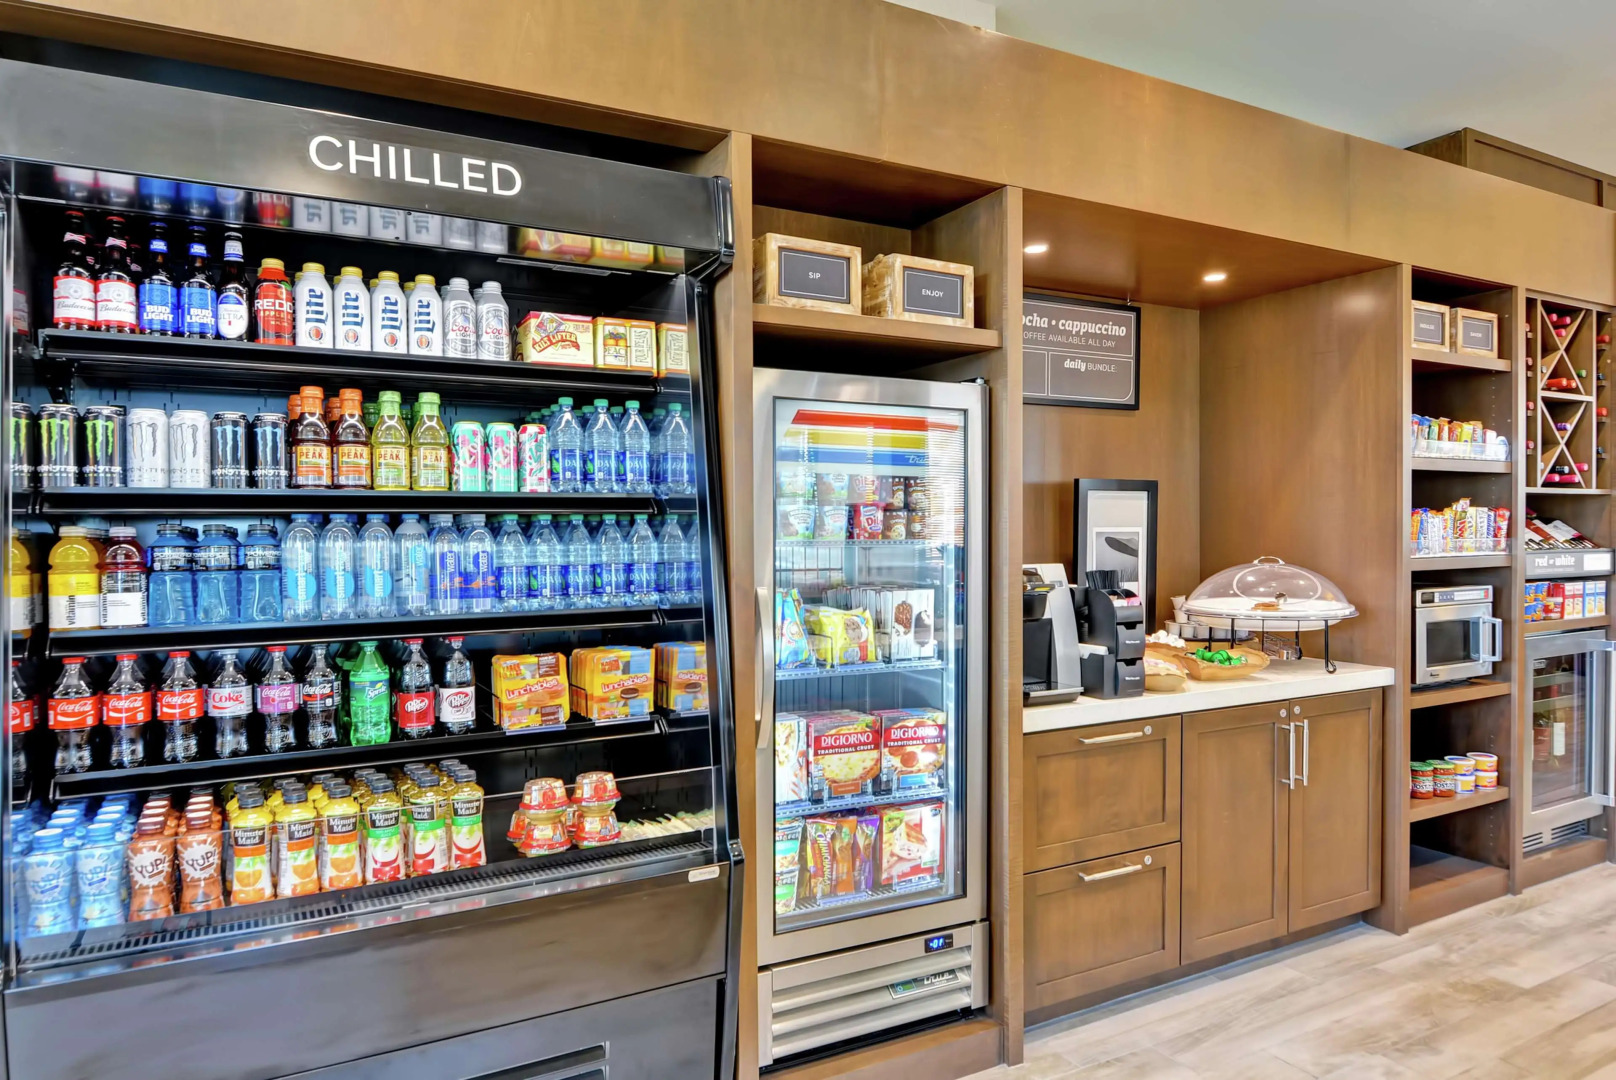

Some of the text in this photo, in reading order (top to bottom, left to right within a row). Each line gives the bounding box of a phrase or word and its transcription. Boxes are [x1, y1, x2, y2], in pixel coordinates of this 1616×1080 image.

[309, 135, 522, 196] CHILLED
[808, 272, 821, 280] SIP
[922, 288, 944, 298] ENJOY
[146, 305, 170, 313] BUD
[190, 308, 212, 316] BUD
[306, 288, 328, 326] Lite
[342, 292, 364, 328] Lite
[381, 296, 402, 330] Lite
[144, 312, 174, 322] LIGHT
[187, 315, 215, 325] LIGHT
[414, 299, 436, 334] Lite
[1058, 320, 1126, 336] cappuccino
[534, 338, 550, 352] KILT
[550, 331, 577, 344] LIFTER
[1048, 334, 1086, 345] AVAILABLE
[1064, 358, 1086, 372] daily
[300, 452, 324, 460] PEAK
[342, 452, 365, 460] PEAK
[1535, 556, 1548, 566] red
[1555, 554, 1576, 566] white
[374, 570, 384, 598] smart
[66, 595, 76, 626] vitamin
[303, 683, 332, 695] Coca-Cola
[506, 678, 558, 700] Lunchables
[602, 675, 648, 692] Lunchables
[262, 686, 292, 698] Coca-Cola
[367, 684, 387, 698] Sprite
[109, 696, 144, 709] Coca-Cola
[162, 692, 196, 705] Coca-Cola
[212, 692, 244, 704] Coke
[57, 700, 94, 713] Coca-Cola
[821, 732, 872, 747] DIGIORNO
[818, 746, 856, 754] TRADITIONAL
[454, 801, 480, 809] Minute
[372, 811, 398, 820] Minute
[458, 807, 476, 816] Maid
[290, 822, 315, 832] Minute
[329, 817, 356, 826] Minute
[376, 818, 396, 827] Maid
[235, 830, 264, 838] Minute
[334, 824, 354, 832] Maid
[238, 836, 260, 844] Maid
[294, 830, 314, 839] Maid
[186, 848, 216, 872] YUP!
[135, 856, 166, 878] YUP!
